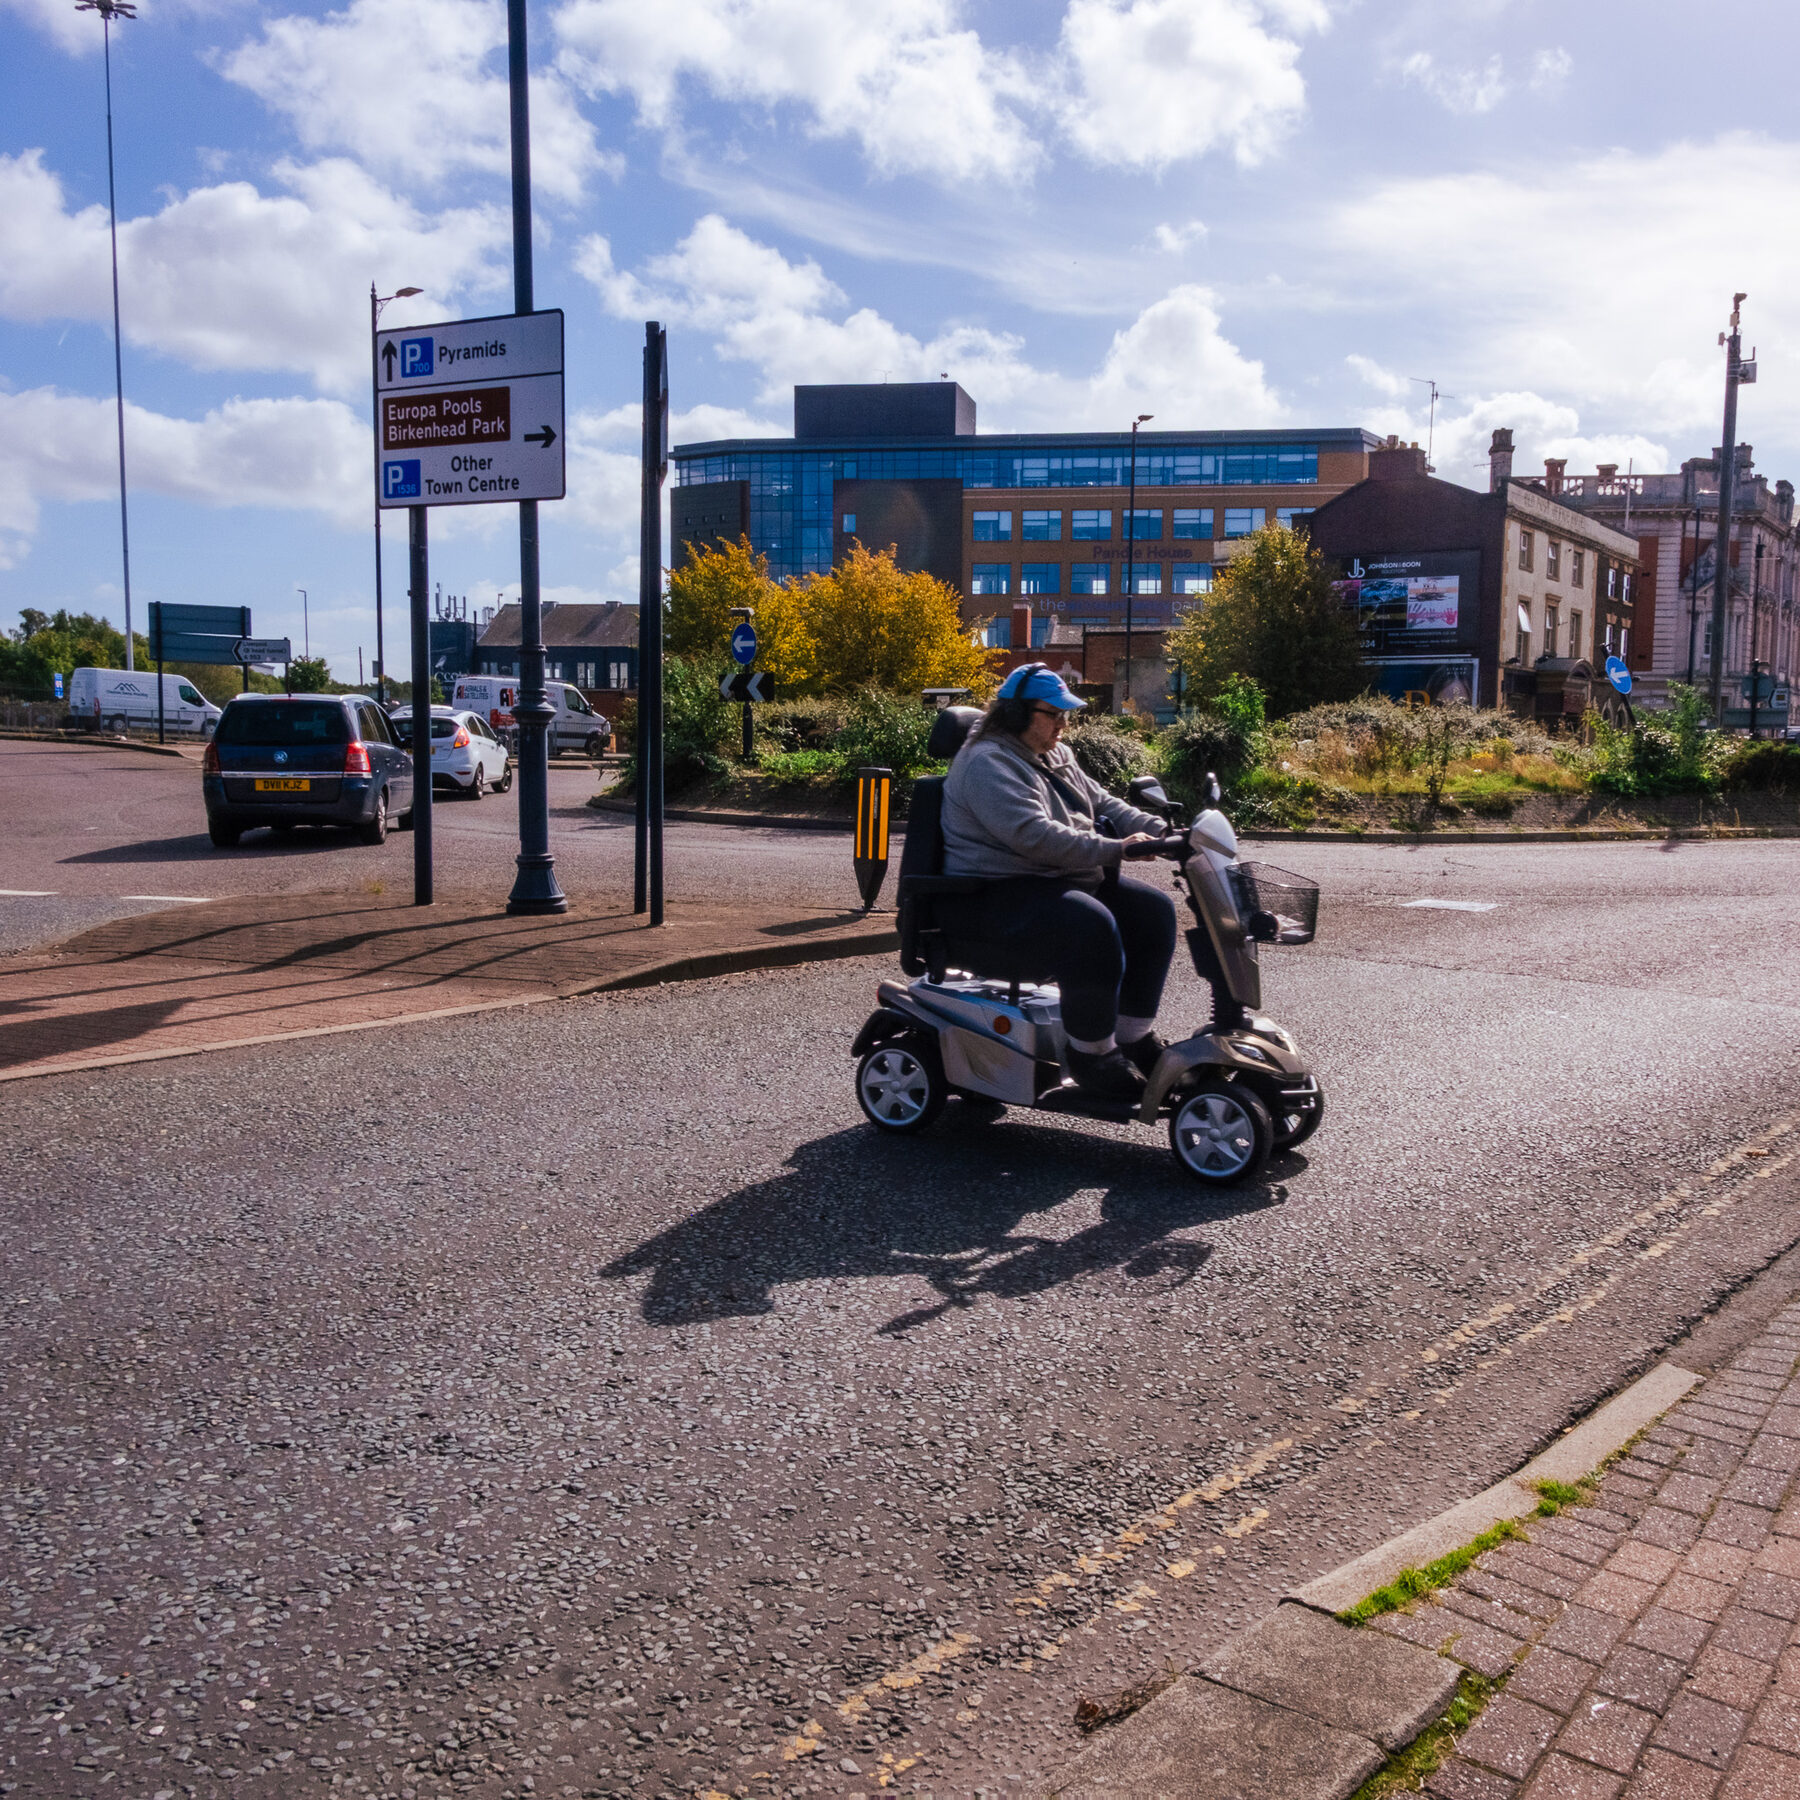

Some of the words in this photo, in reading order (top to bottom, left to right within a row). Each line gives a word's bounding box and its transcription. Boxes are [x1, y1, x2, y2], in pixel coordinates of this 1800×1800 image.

[405, 343, 421, 374] P
[439, 340, 506, 364] Pyramids
[413, 363, 430, 373] 700
[388, 404, 436, 421] Europa
[443, 397, 482, 416] Pools
[388, 420, 466, 442] Birkenhead
[472, 417, 505, 435] Park
[451, 455, 493, 473] Other
[387, 465, 403, 495] P
[425, 479, 463, 495] Town
[468, 475, 520, 492] Centre
[1147, 545, 1192, 559] House
[1040, 599, 1066, 611] the
[464, 692, 488, 700] SATELLITES
[500, 688, 514, 707] A1
